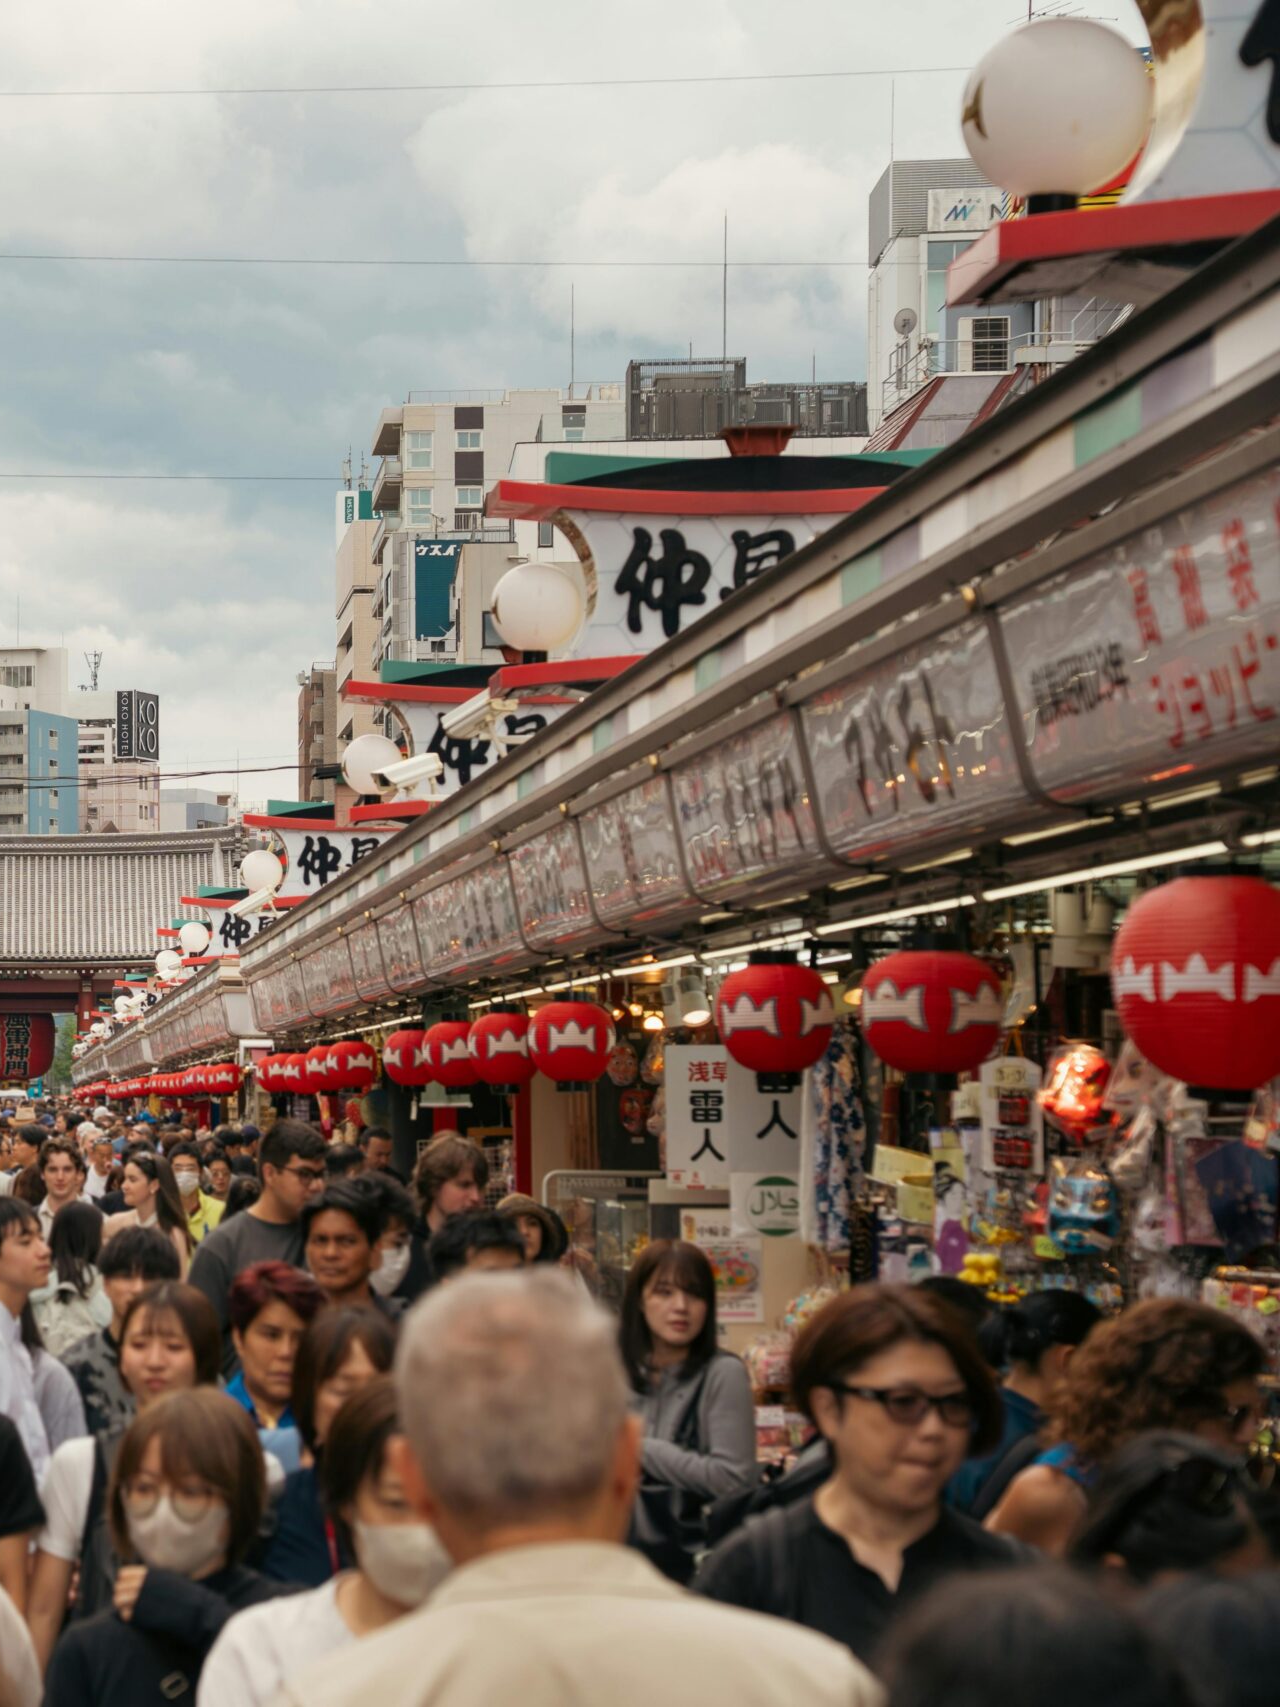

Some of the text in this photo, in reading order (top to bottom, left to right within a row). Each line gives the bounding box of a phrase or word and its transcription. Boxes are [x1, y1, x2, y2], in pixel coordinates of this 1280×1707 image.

[121, 692, 129, 756] KOKO HOTEL
[139, 700, 157, 725] KO
[139, 727, 157, 753] KO
[688, 1061, 727, 1083] 浅草
[689, 1089, 725, 1162] 雷人
